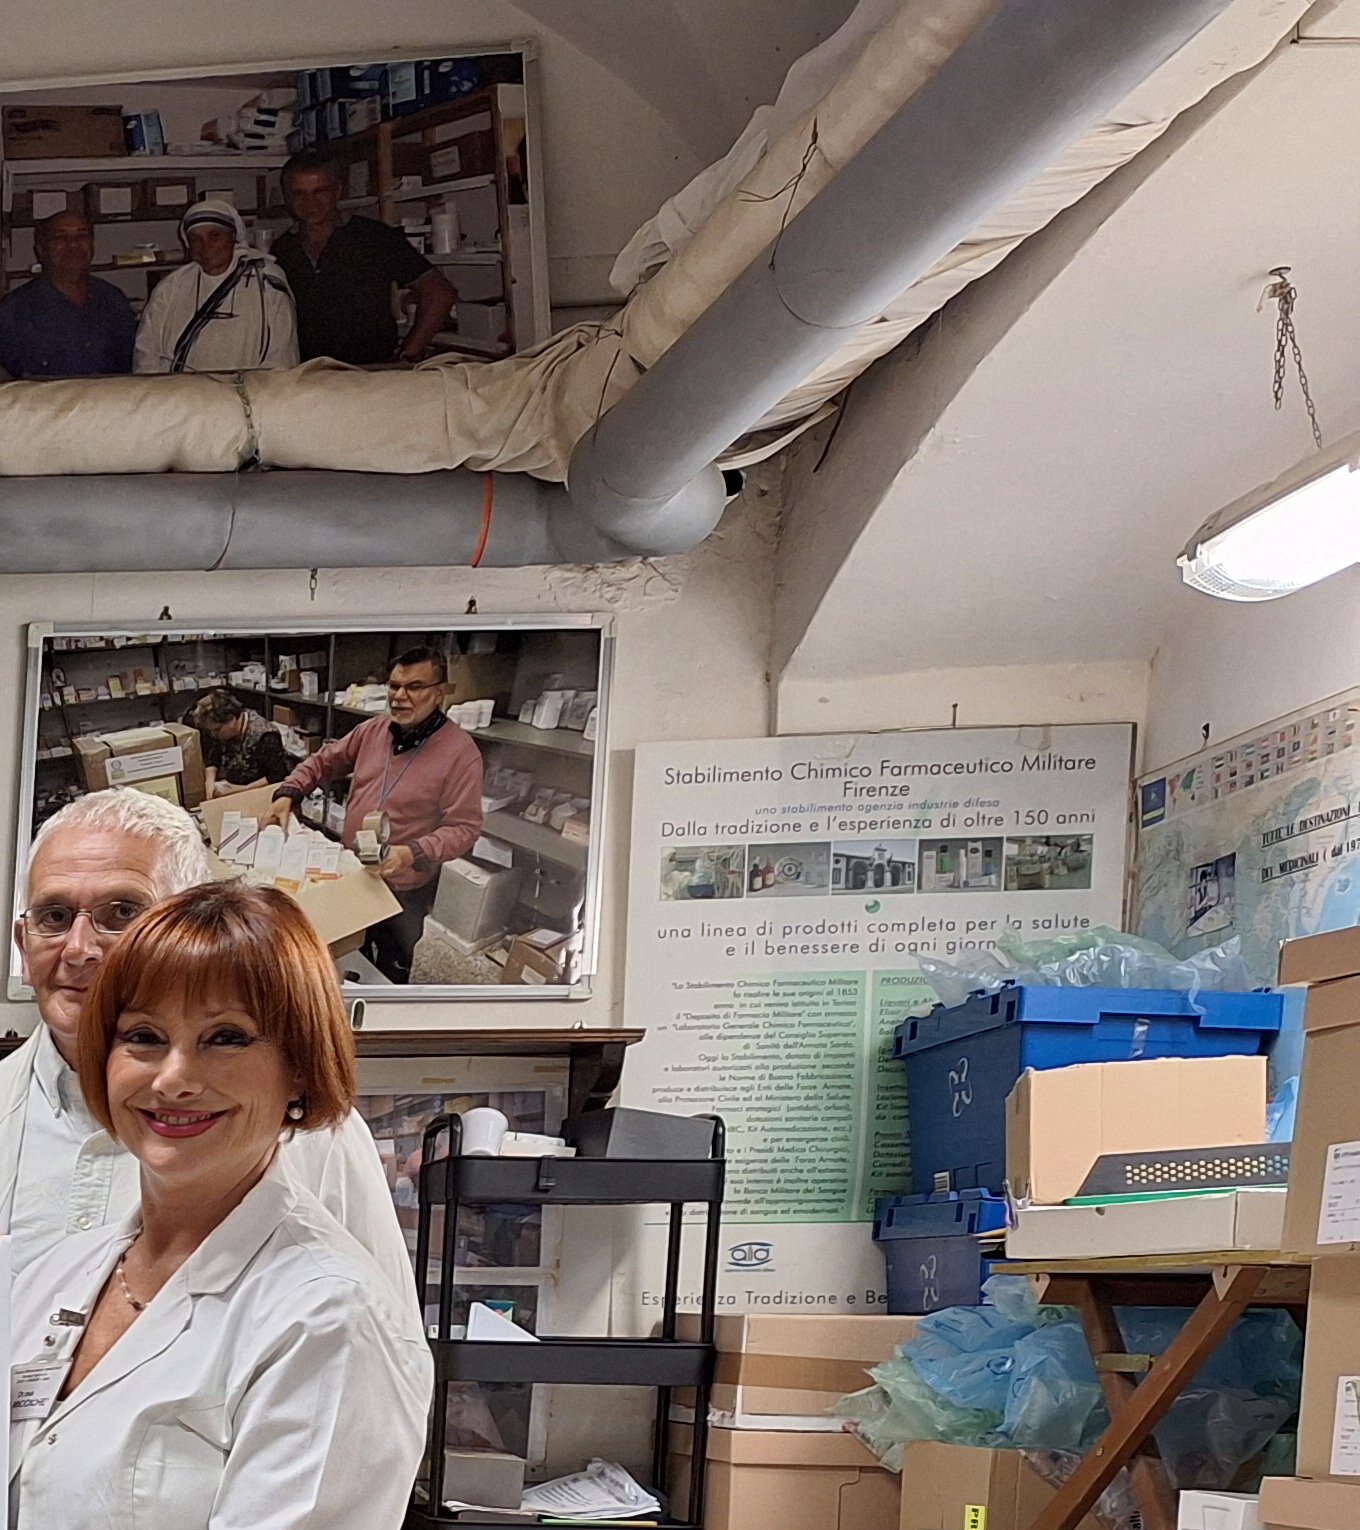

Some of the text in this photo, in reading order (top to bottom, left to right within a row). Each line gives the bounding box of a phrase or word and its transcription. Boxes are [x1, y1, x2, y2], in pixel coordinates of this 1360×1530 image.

[664, 754, 1096, 786] Stabilimento Chimico Farmaceutico Militare
[842, 780, 910, 798] Firenze
[661, 808, 1096, 837] Dalla tradizione e l'esperienza di oltre 150 anni
[658, 926, 691, 939] una
[701, 921, 748, 937] linea
[755, 920, 774, 936] di
[782, 919, 858, 939] prodotti
[866, 915, 957, 937] completa
[965, 918, 996, 934] per
[1031, 912, 1090, 930] salute
[725, 942, 737, 957] e
[745, 940, 755, 956] il
[764, 938, 860, 956] benessere
[869, 937, 886, 954] di
[745, 1290, 837, 1305] Tradizione
[846, 1295, 856, 1304] e
